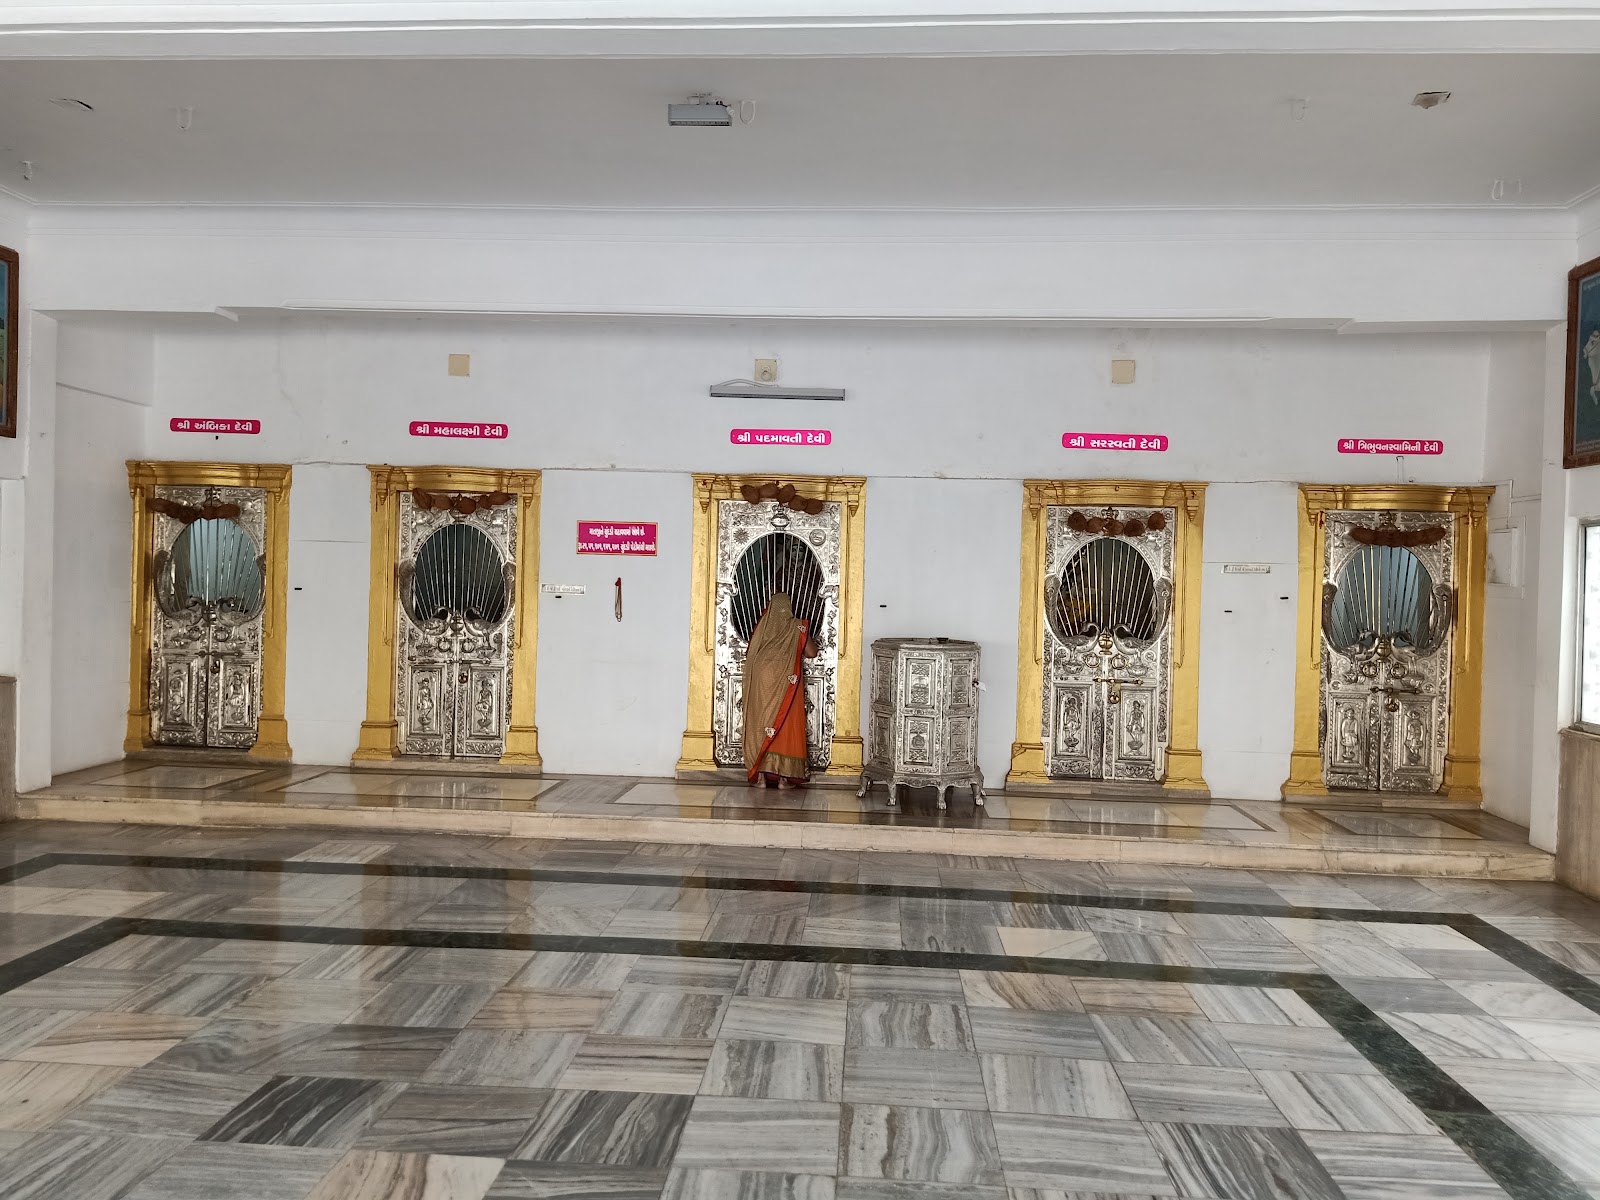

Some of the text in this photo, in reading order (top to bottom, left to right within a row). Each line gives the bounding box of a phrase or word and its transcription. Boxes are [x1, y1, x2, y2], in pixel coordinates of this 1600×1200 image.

[177, 420, 253, 432] શ્રી અંબિકા દેવી
[416, 424, 503, 437] શ્રી મહાલક્ષ્મી દેવી
[737, 431, 826, 445] શ્રી પદમાવતી દેવી
[1069, 436, 1161, 450] શ્રી સરસ્વતી દેવી
[1343, 440, 1439, 453] શ્રી ત્રિભુવનસ્વામિની દેવી
